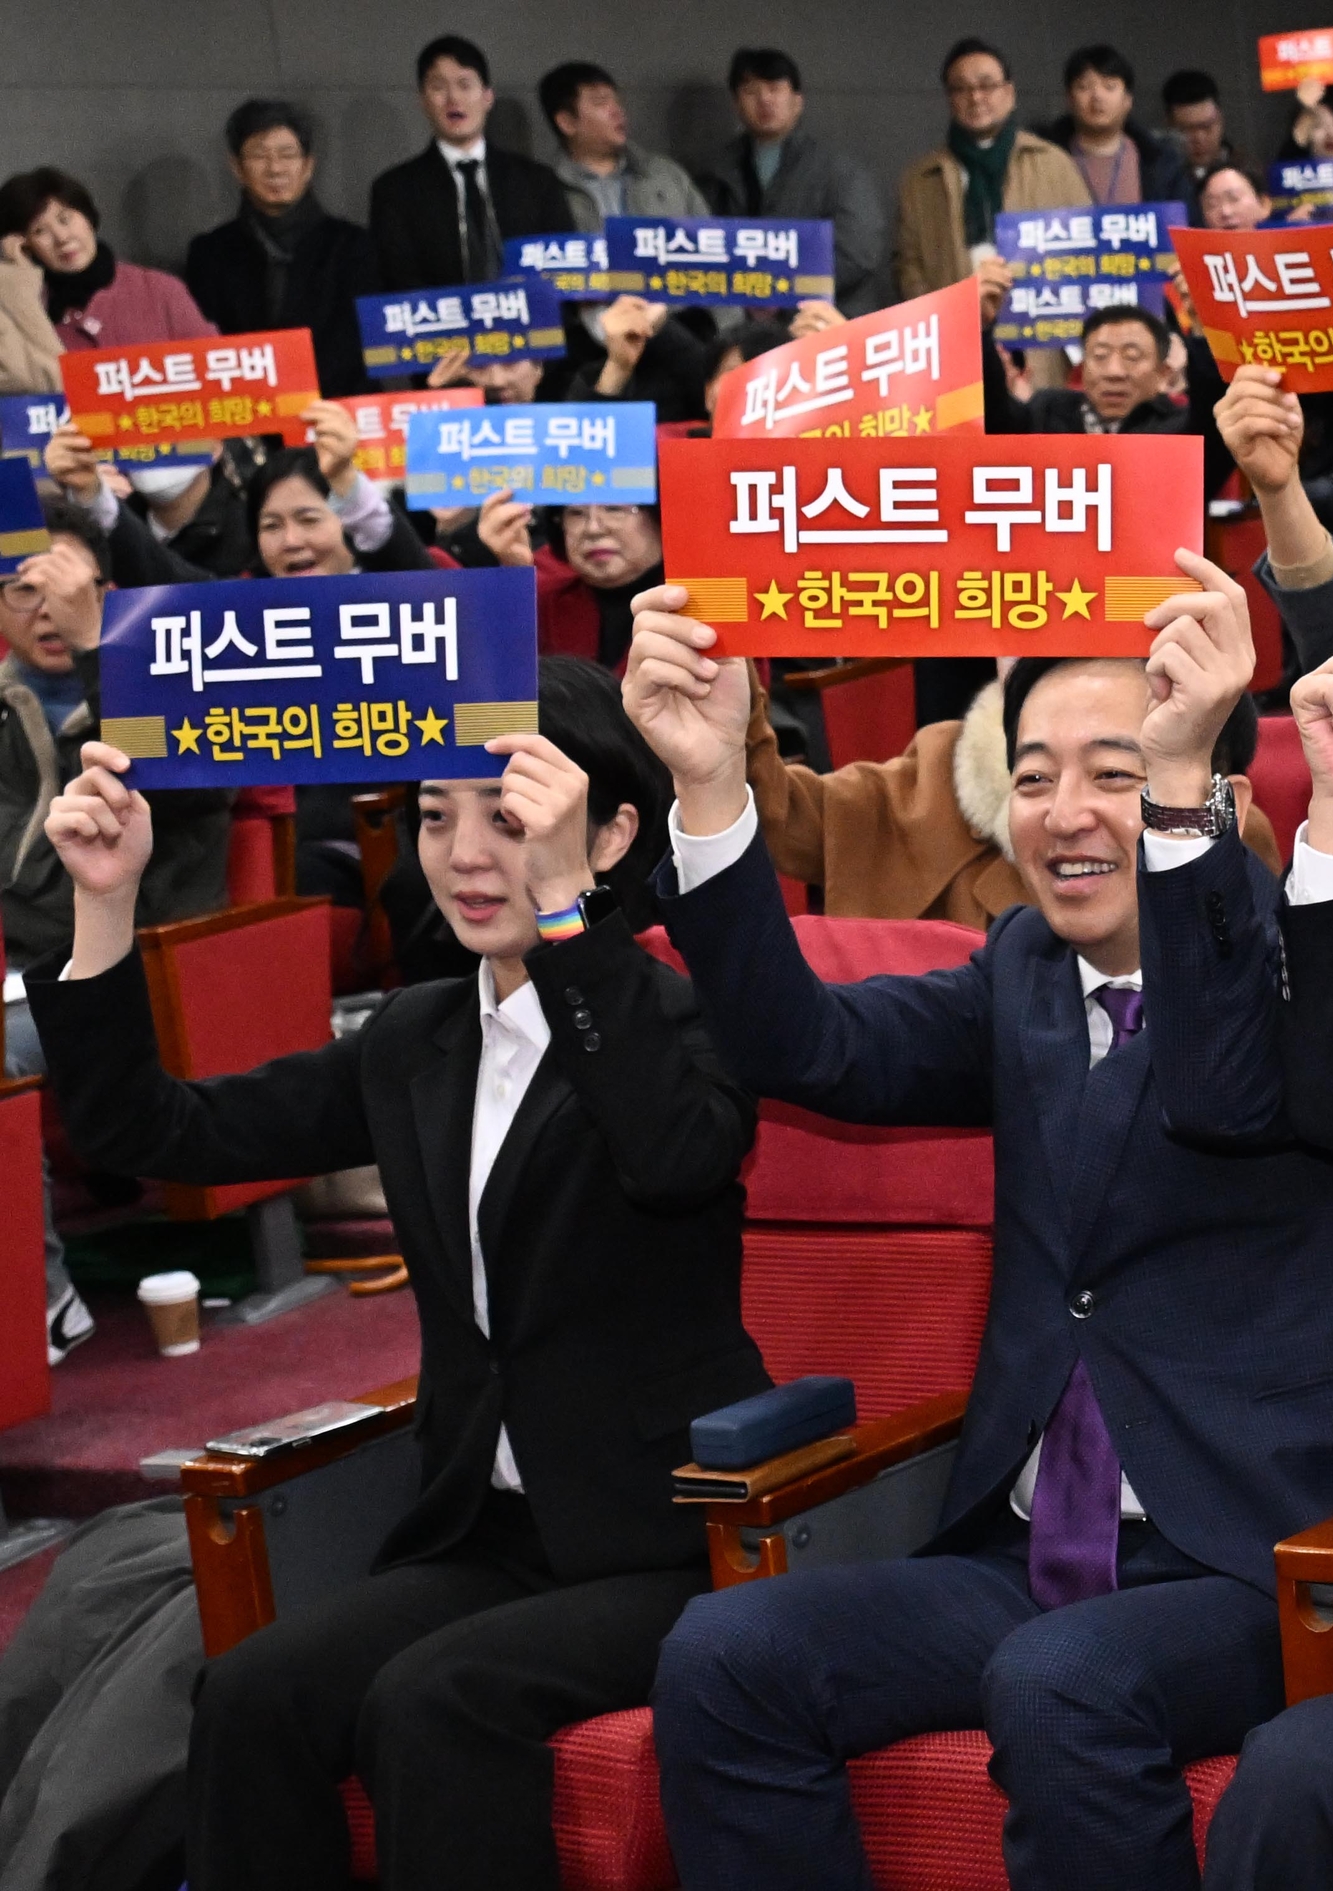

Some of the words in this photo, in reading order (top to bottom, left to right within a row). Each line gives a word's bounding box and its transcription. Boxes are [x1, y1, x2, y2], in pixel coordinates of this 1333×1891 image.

[633, 228, 731, 266] 퍼스트
[733, 228, 799, 268] 무버
[1018, 216, 1097, 253] 퍼스트
[1099, 211, 1158, 250] 무버
[519, 240, 589, 271] 퍼스트
[665, 269, 727, 297] 한국의
[732, 271, 772, 298] 희망
[1010, 285, 1086, 318] 퍼스트
[1203, 251, 1331, 318] 퍼스트
[383, 302, 469, 336] 퍼스트
[470, 290, 531, 327] 무버
[94, 355, 202, 401] 퍼스트
[205, 343, 278, 392] 무버
[742, 343, 855, 429] 퍼스트
[861, 314, 940, 398] 무버
[135, 401, 205, 434] 한국의
[209, 396, 254, 425] 희망
[437, 418, 540, 461] 퍼스트
[543, 416, 617, 459] 무버
[729, 465, 948, 553] 퍼스트
[964, 463, 1112, 552] 무버
[797, 570, 940, 629] 한국의
[955, 570, 1053, 630] 희망
[149, 606, 322, 692] 퍼스트
[333, 597, 459, 685] 무버
[204, 703, 322, 762] 한국의
[332, 699, 412, 758] 희망
